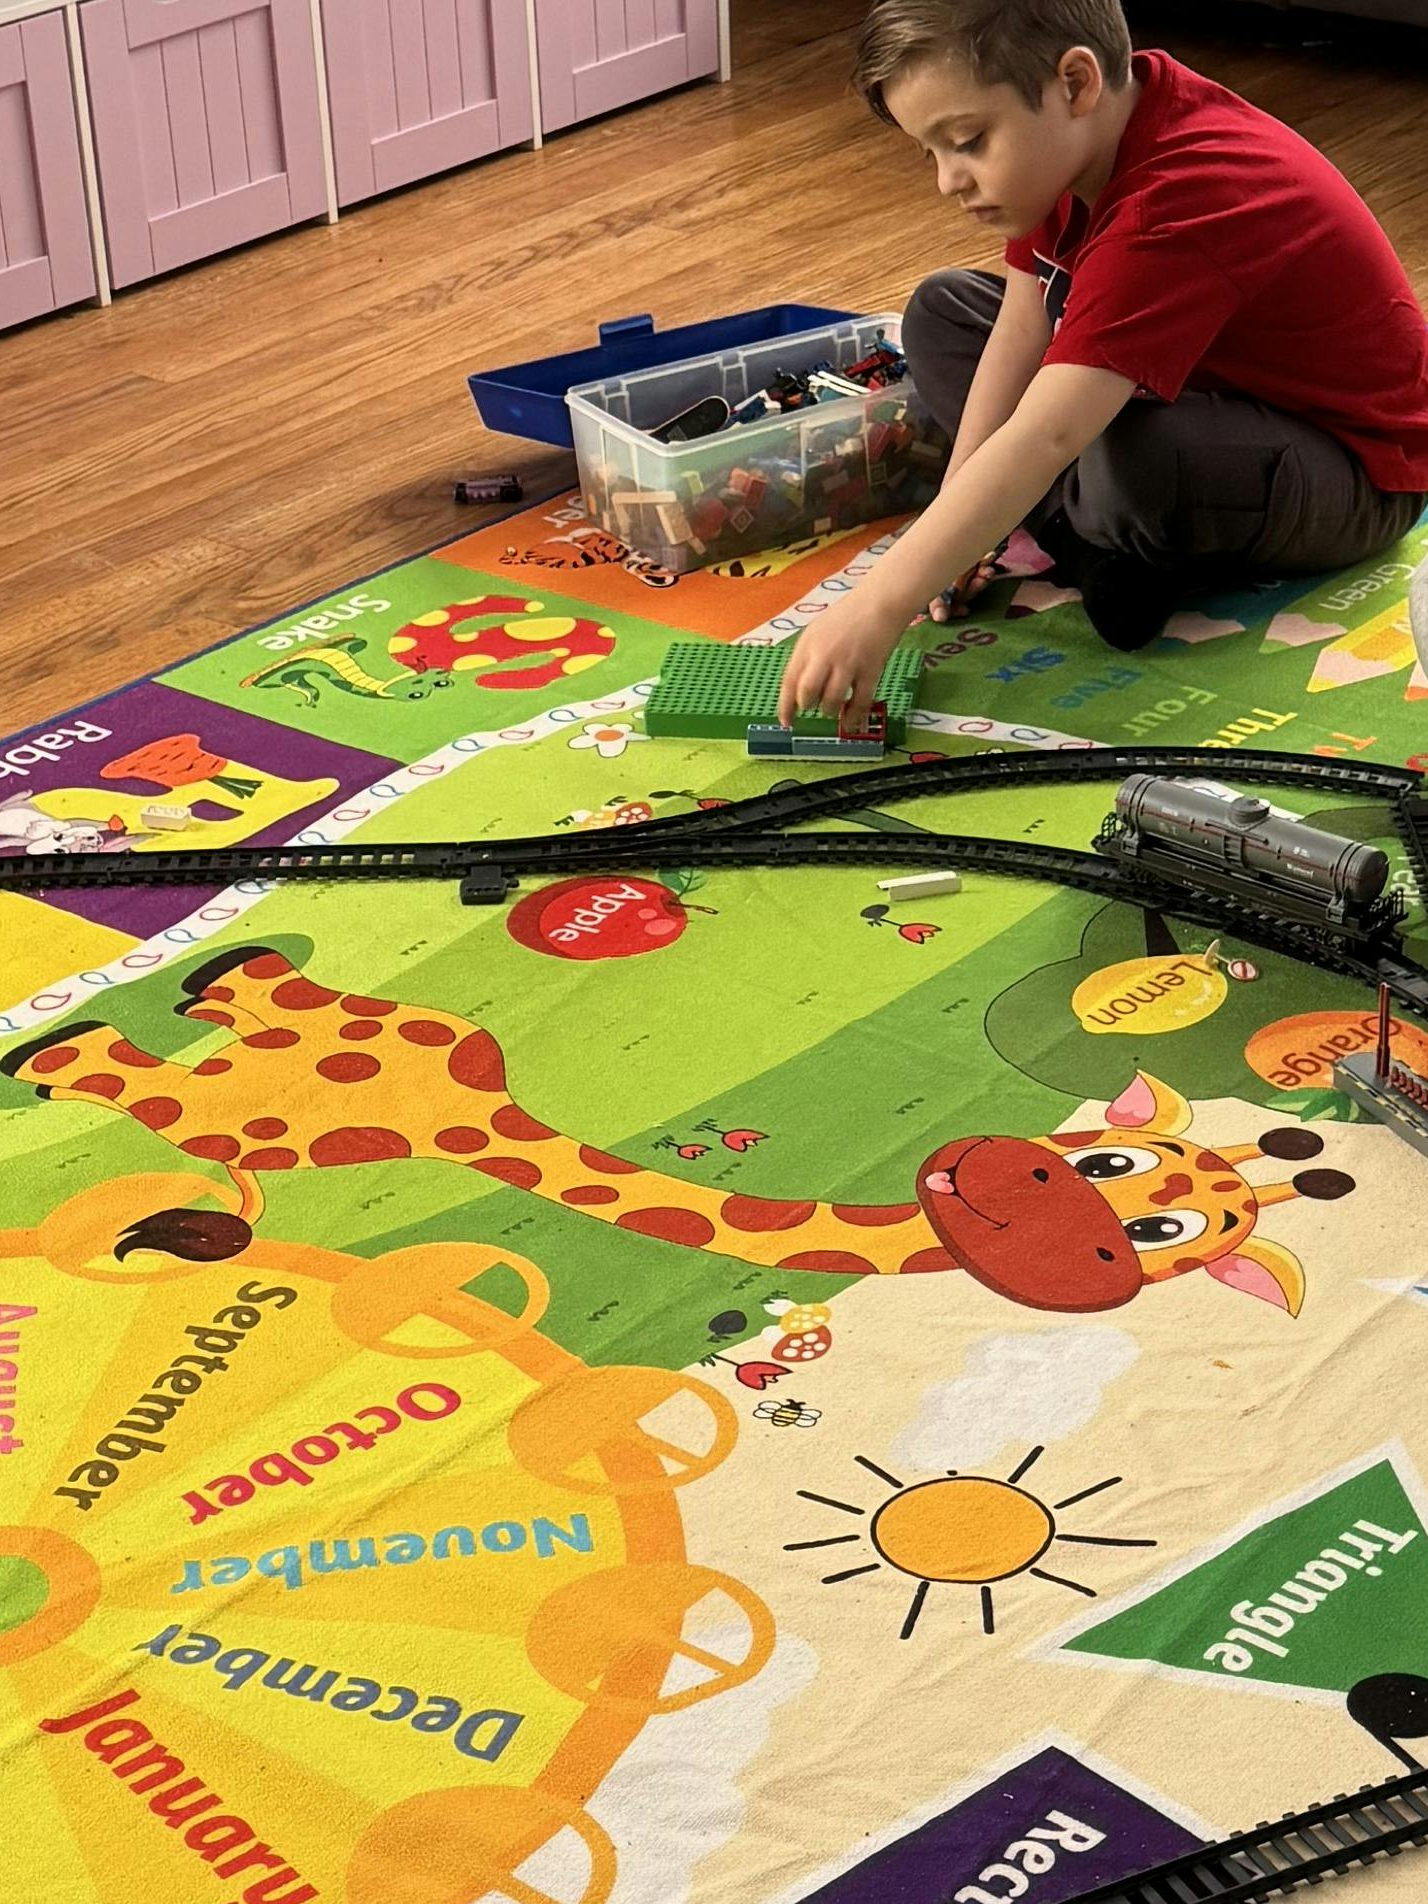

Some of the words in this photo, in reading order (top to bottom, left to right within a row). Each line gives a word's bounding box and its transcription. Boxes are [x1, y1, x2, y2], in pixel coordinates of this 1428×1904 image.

[1319, 564, 1415, 611] Green
[257, 593, 391, 654] Snake
[924, 628, 998, 669] Sev
[986, 647, 1066, 683] Six
[1050, 664, 1144, 710] Five
[1122, 686, 1218, 738] Four
[1198, 708, 1299, 748] Thr
[550, 883, 651, 946] Apple
[1086, 961, 1213, 1026] Lemon
[1268, 1016, 1403, 1088] Orange
[53, 1281, 297, 1512] September
[185, 1382, 461, 1524] October
[170, 1513, 593, 1594] November
[1201, 1514, 1422, 1679] Triangle
[143, 1621, 522, 1763] December
